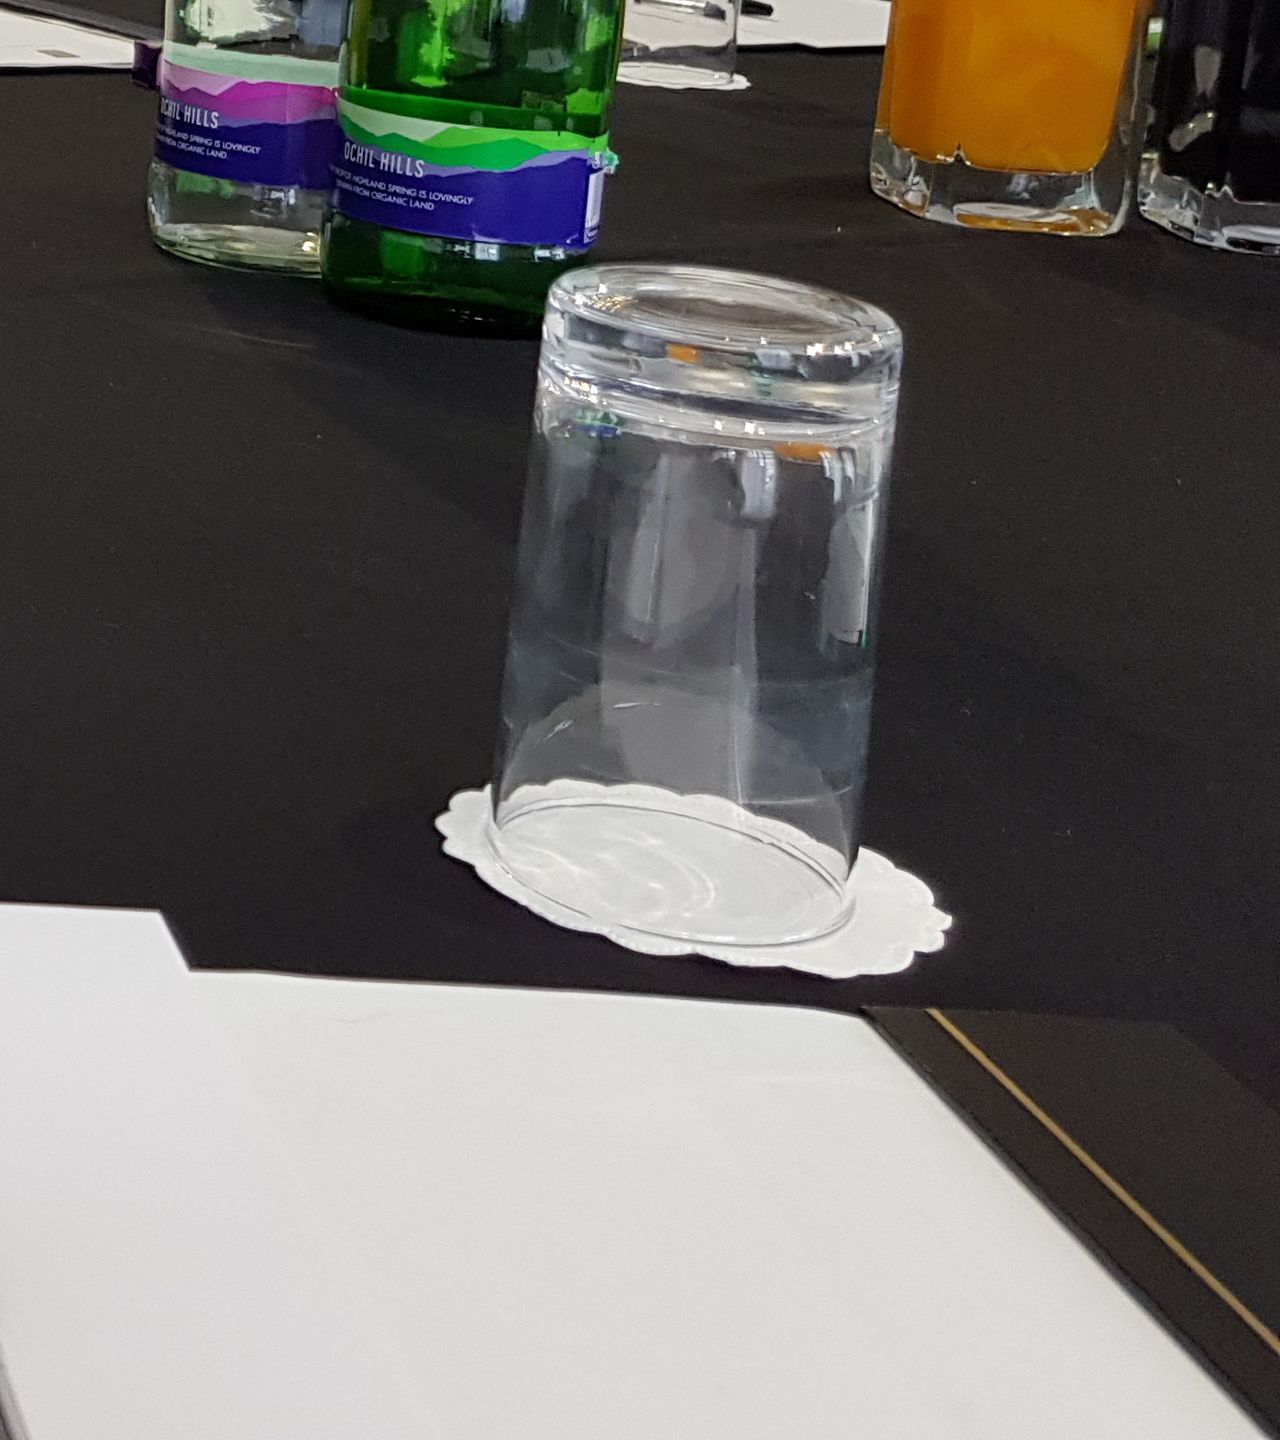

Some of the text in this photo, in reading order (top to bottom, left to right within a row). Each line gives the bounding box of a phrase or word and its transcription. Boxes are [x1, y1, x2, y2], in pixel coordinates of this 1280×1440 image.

[183, 105, 220, 129] HILLS
[344, 141, 376, 169] OCHIL
[379, 151, 425, 179] HILLS
[410, 199, 436, 211] LAND
[429, 192, 474, 206] LOVINGLY
